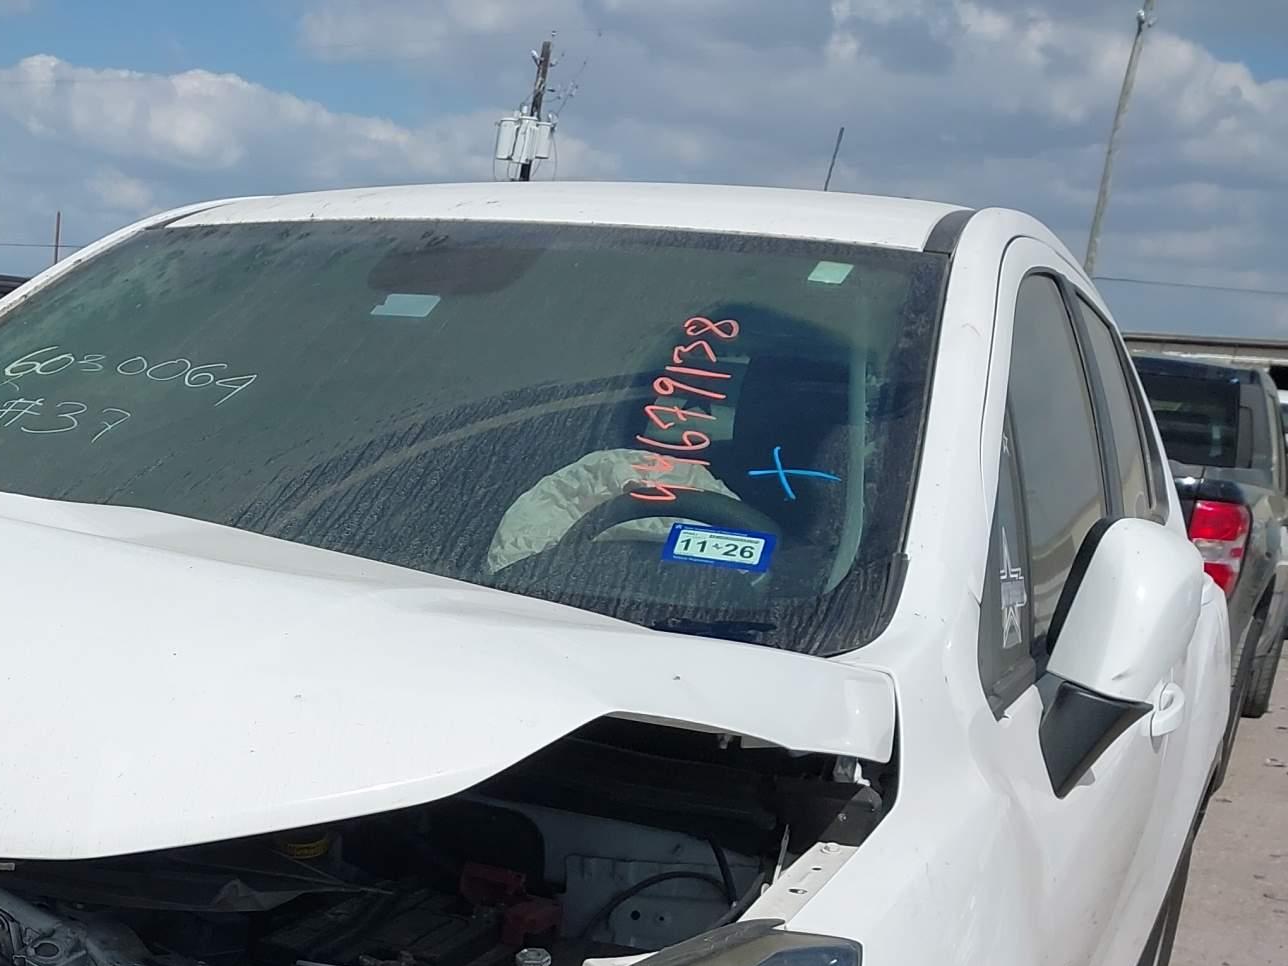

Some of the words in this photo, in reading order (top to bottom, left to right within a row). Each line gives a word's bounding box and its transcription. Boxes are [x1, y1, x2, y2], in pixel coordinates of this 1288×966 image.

[629, 315, 740, 501] 44679138
[679, 538, 708, 553] 11
[721, 543, 756, 559] 26
